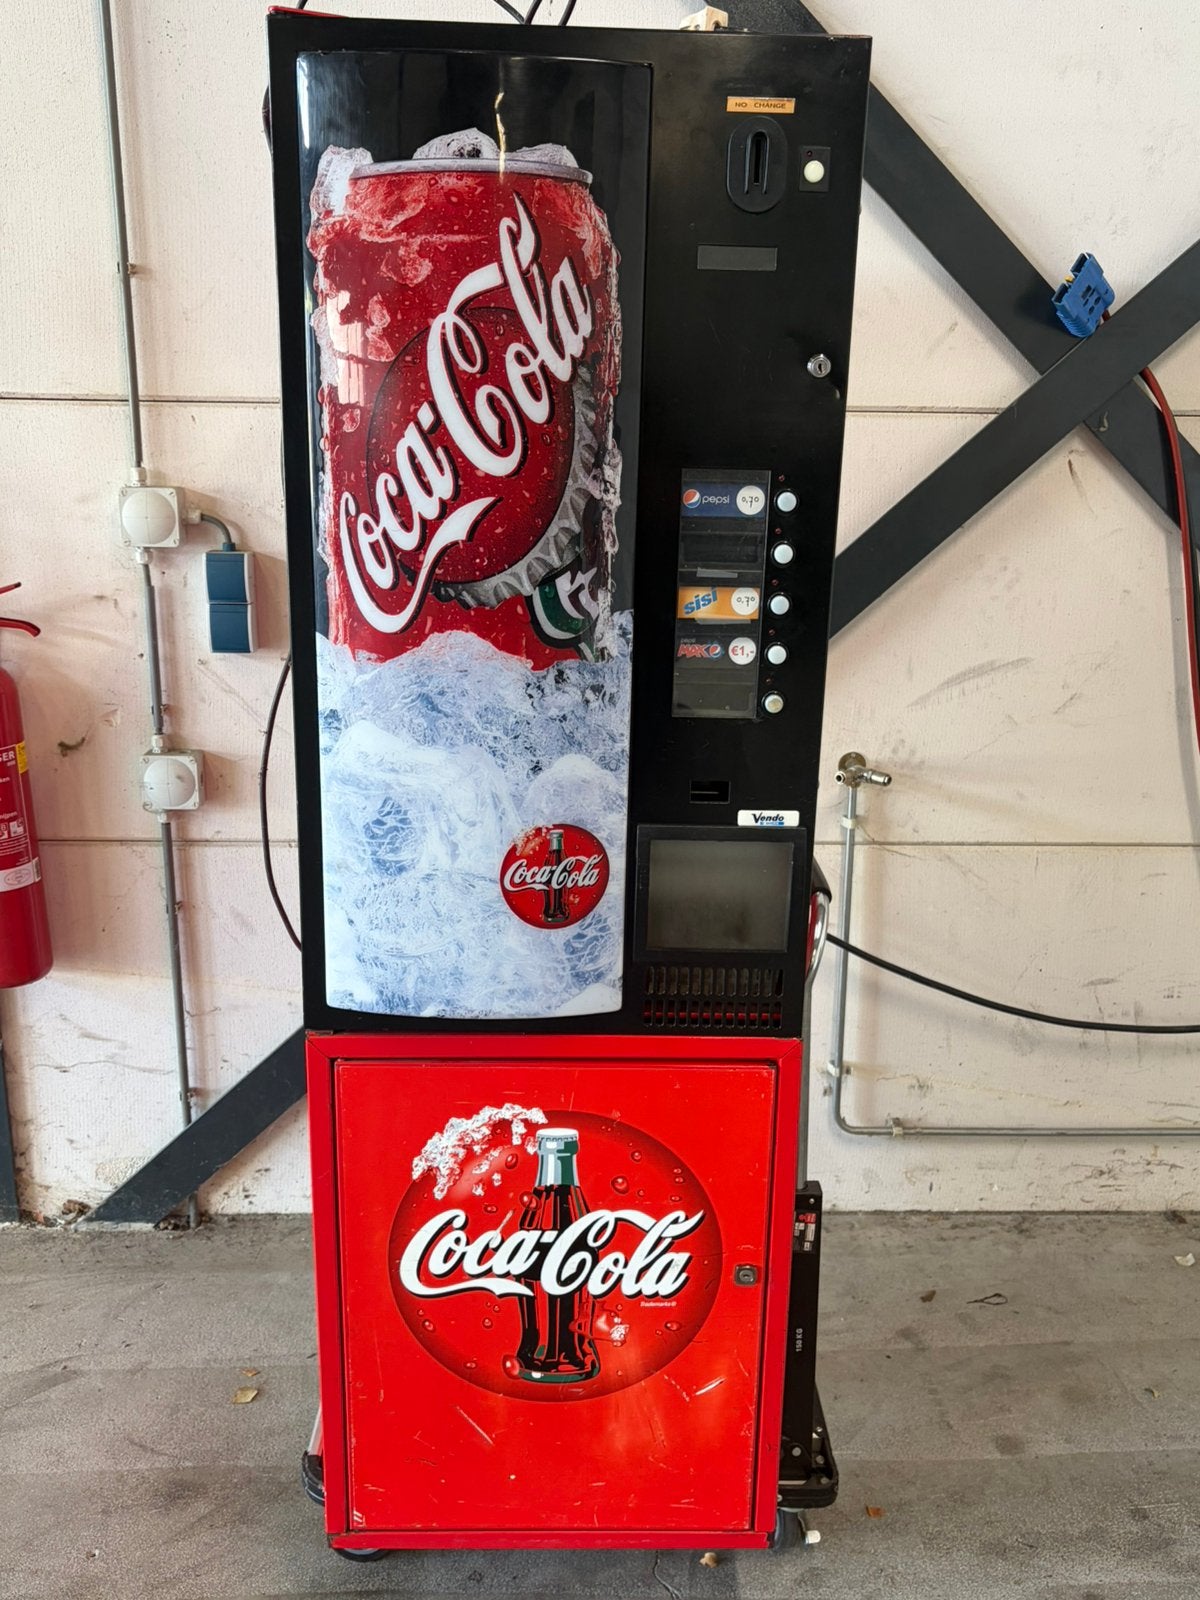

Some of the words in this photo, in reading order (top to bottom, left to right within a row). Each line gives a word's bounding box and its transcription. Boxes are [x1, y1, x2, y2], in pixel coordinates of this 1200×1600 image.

[734, 101, 748, 109] NO
[340, 190, 593, 634] Coca-Cola
[702, 495, 730, 505] pepsi
[731, 645, 755, 658] €1,-
[752, 812, 785, 824] Vendo
[503, 853, 604, 892] Coca-Cola
[399, 1208, 704, 1298] Coca-Cola
[795, 1328, 803, 1339] KG
[795, 1340, 803, 1352] 150
